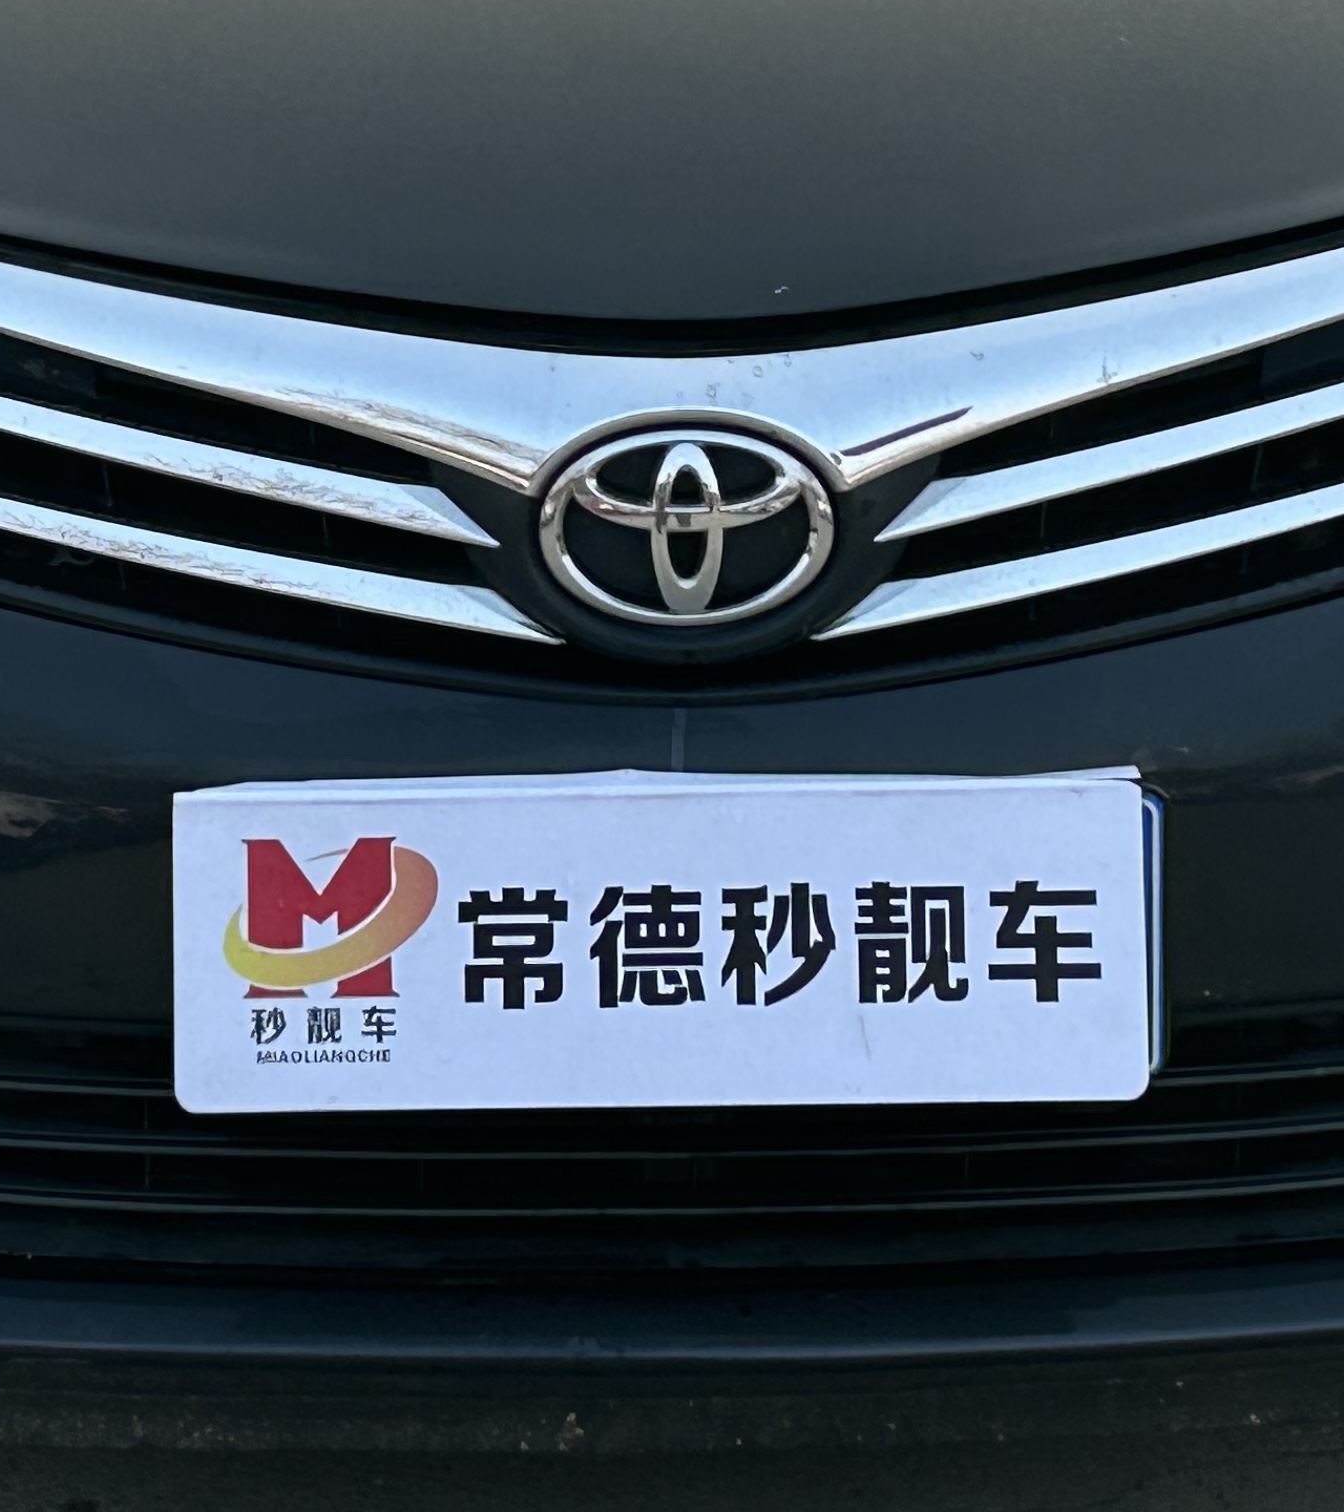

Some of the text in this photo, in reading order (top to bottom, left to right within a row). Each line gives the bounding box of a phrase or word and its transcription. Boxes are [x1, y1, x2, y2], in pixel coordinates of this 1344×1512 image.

[458, 880, 1102, 1010] 常德秒靓车
[250, 1005, 397, 1045] 秒靓车
[256, 1048, 392, 1064] MIAOLIANGCHE
